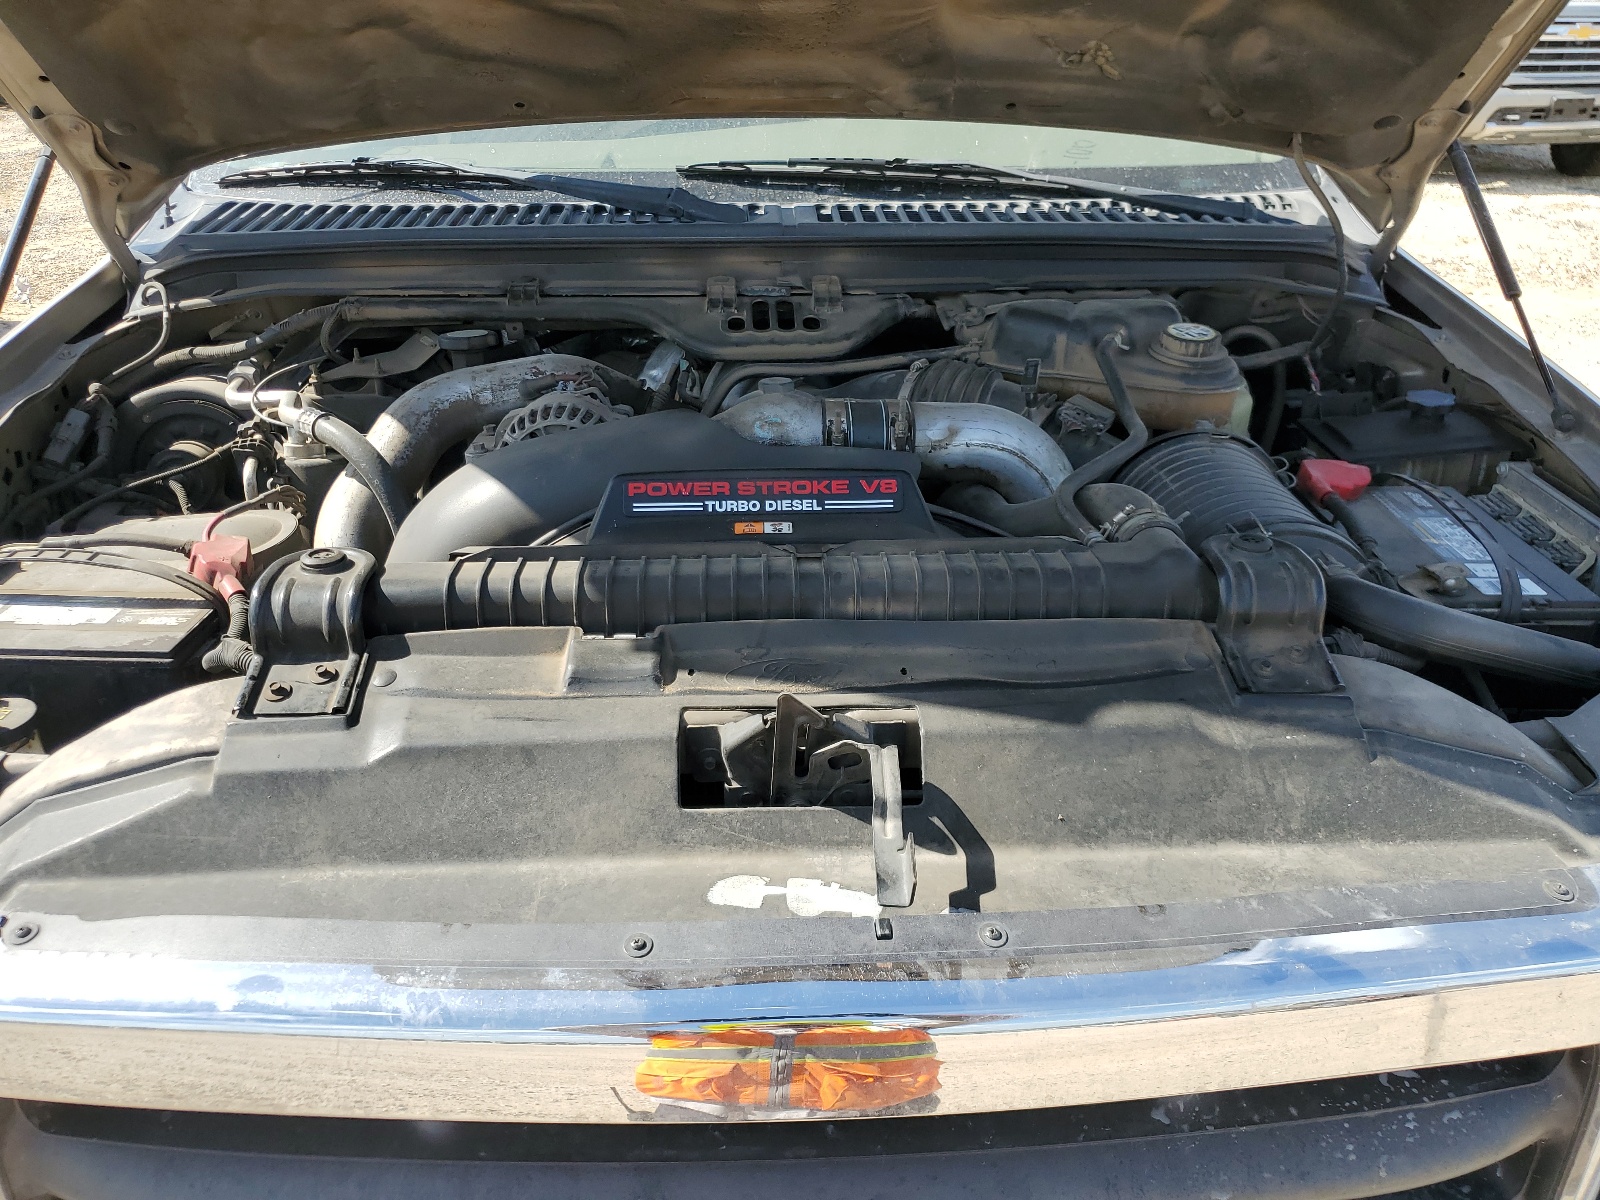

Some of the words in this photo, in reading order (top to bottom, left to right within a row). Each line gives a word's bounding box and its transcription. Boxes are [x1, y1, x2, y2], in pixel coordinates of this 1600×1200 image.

[627, 481, 730, 497] POWER
[737, 479, 849, 495] STROKE
[860, 479, 898, 493] V8
[704, 499, 760, 512] TURBO
[765, 499, 823, 512] DIESEL
